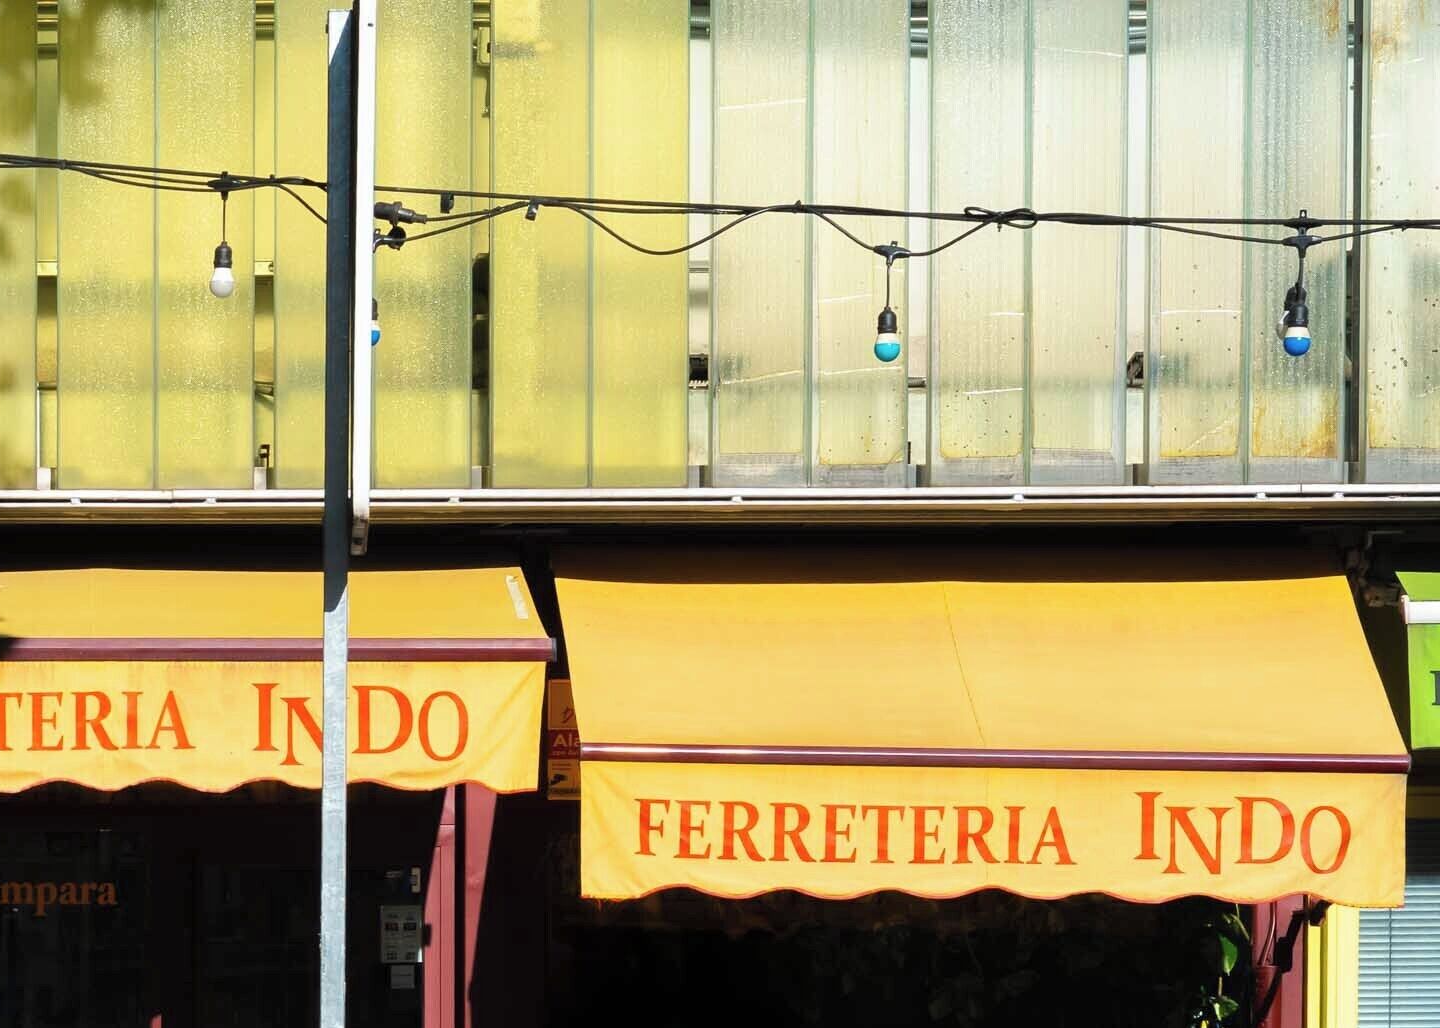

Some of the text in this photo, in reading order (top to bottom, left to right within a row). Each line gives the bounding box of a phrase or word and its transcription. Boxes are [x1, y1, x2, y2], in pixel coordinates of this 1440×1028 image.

[251, 682, 469, 766] INDO
[633, 791, 1352, 875] FERRETERIA INDO
